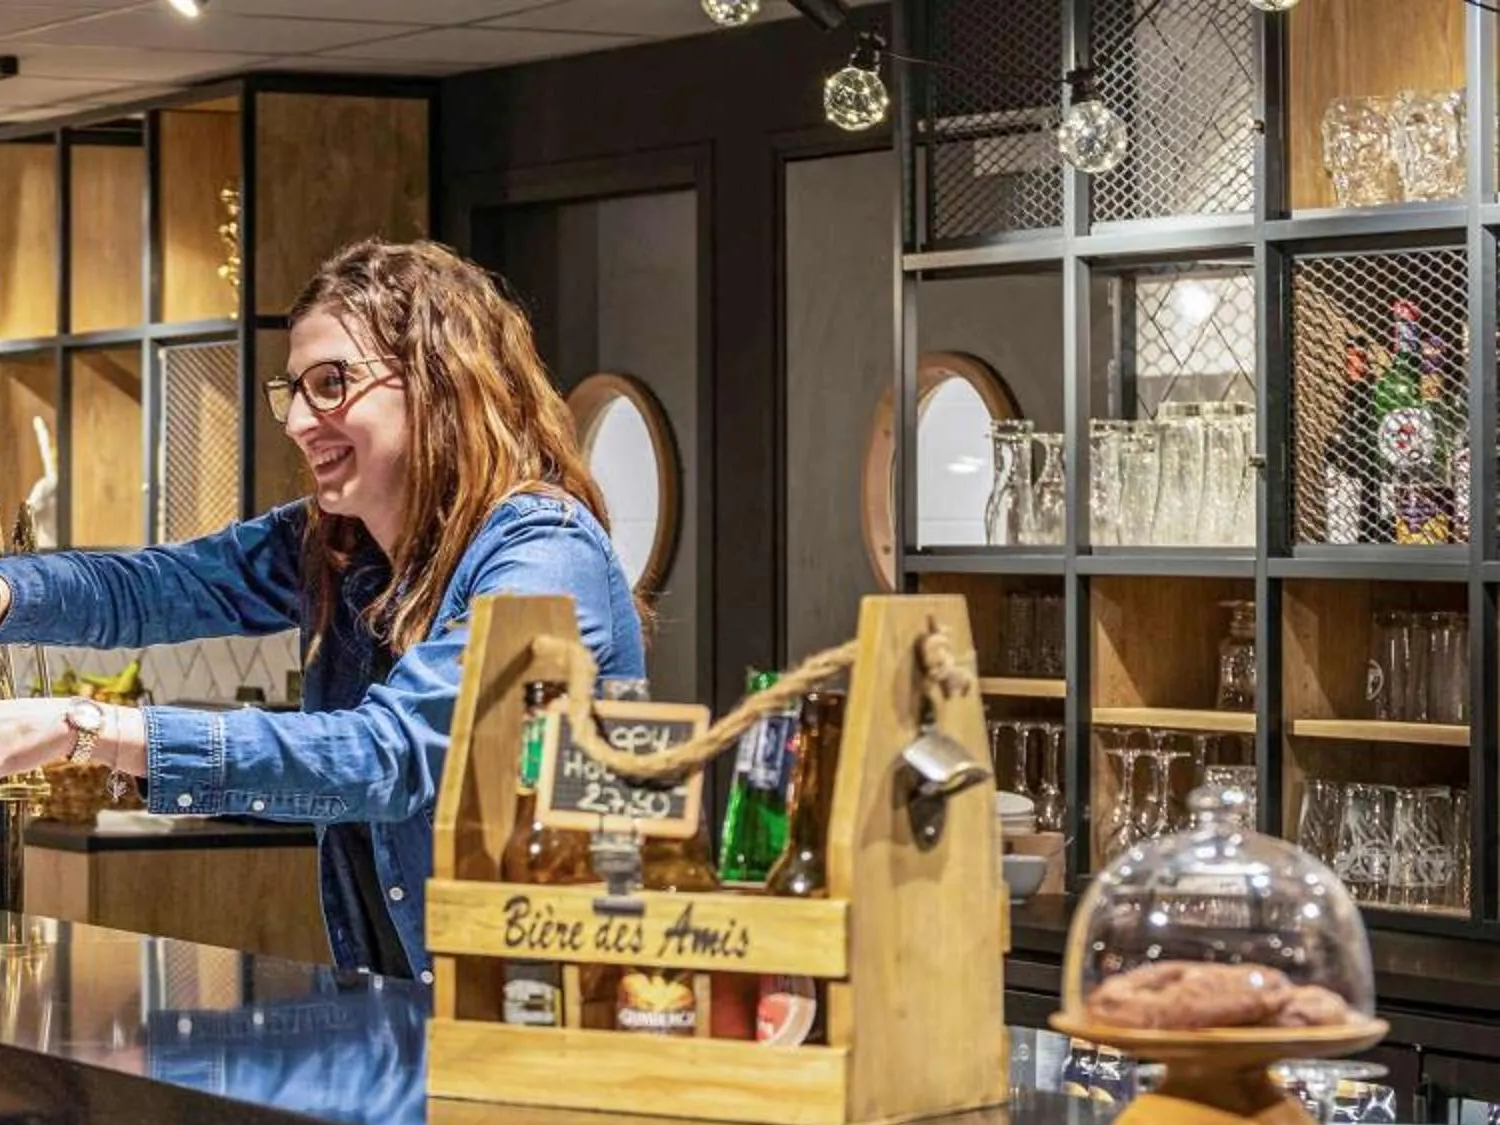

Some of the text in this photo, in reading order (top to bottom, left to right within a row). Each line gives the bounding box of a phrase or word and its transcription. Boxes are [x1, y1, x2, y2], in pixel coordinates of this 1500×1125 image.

[503, 895, 749, 957] Bière des Amis
